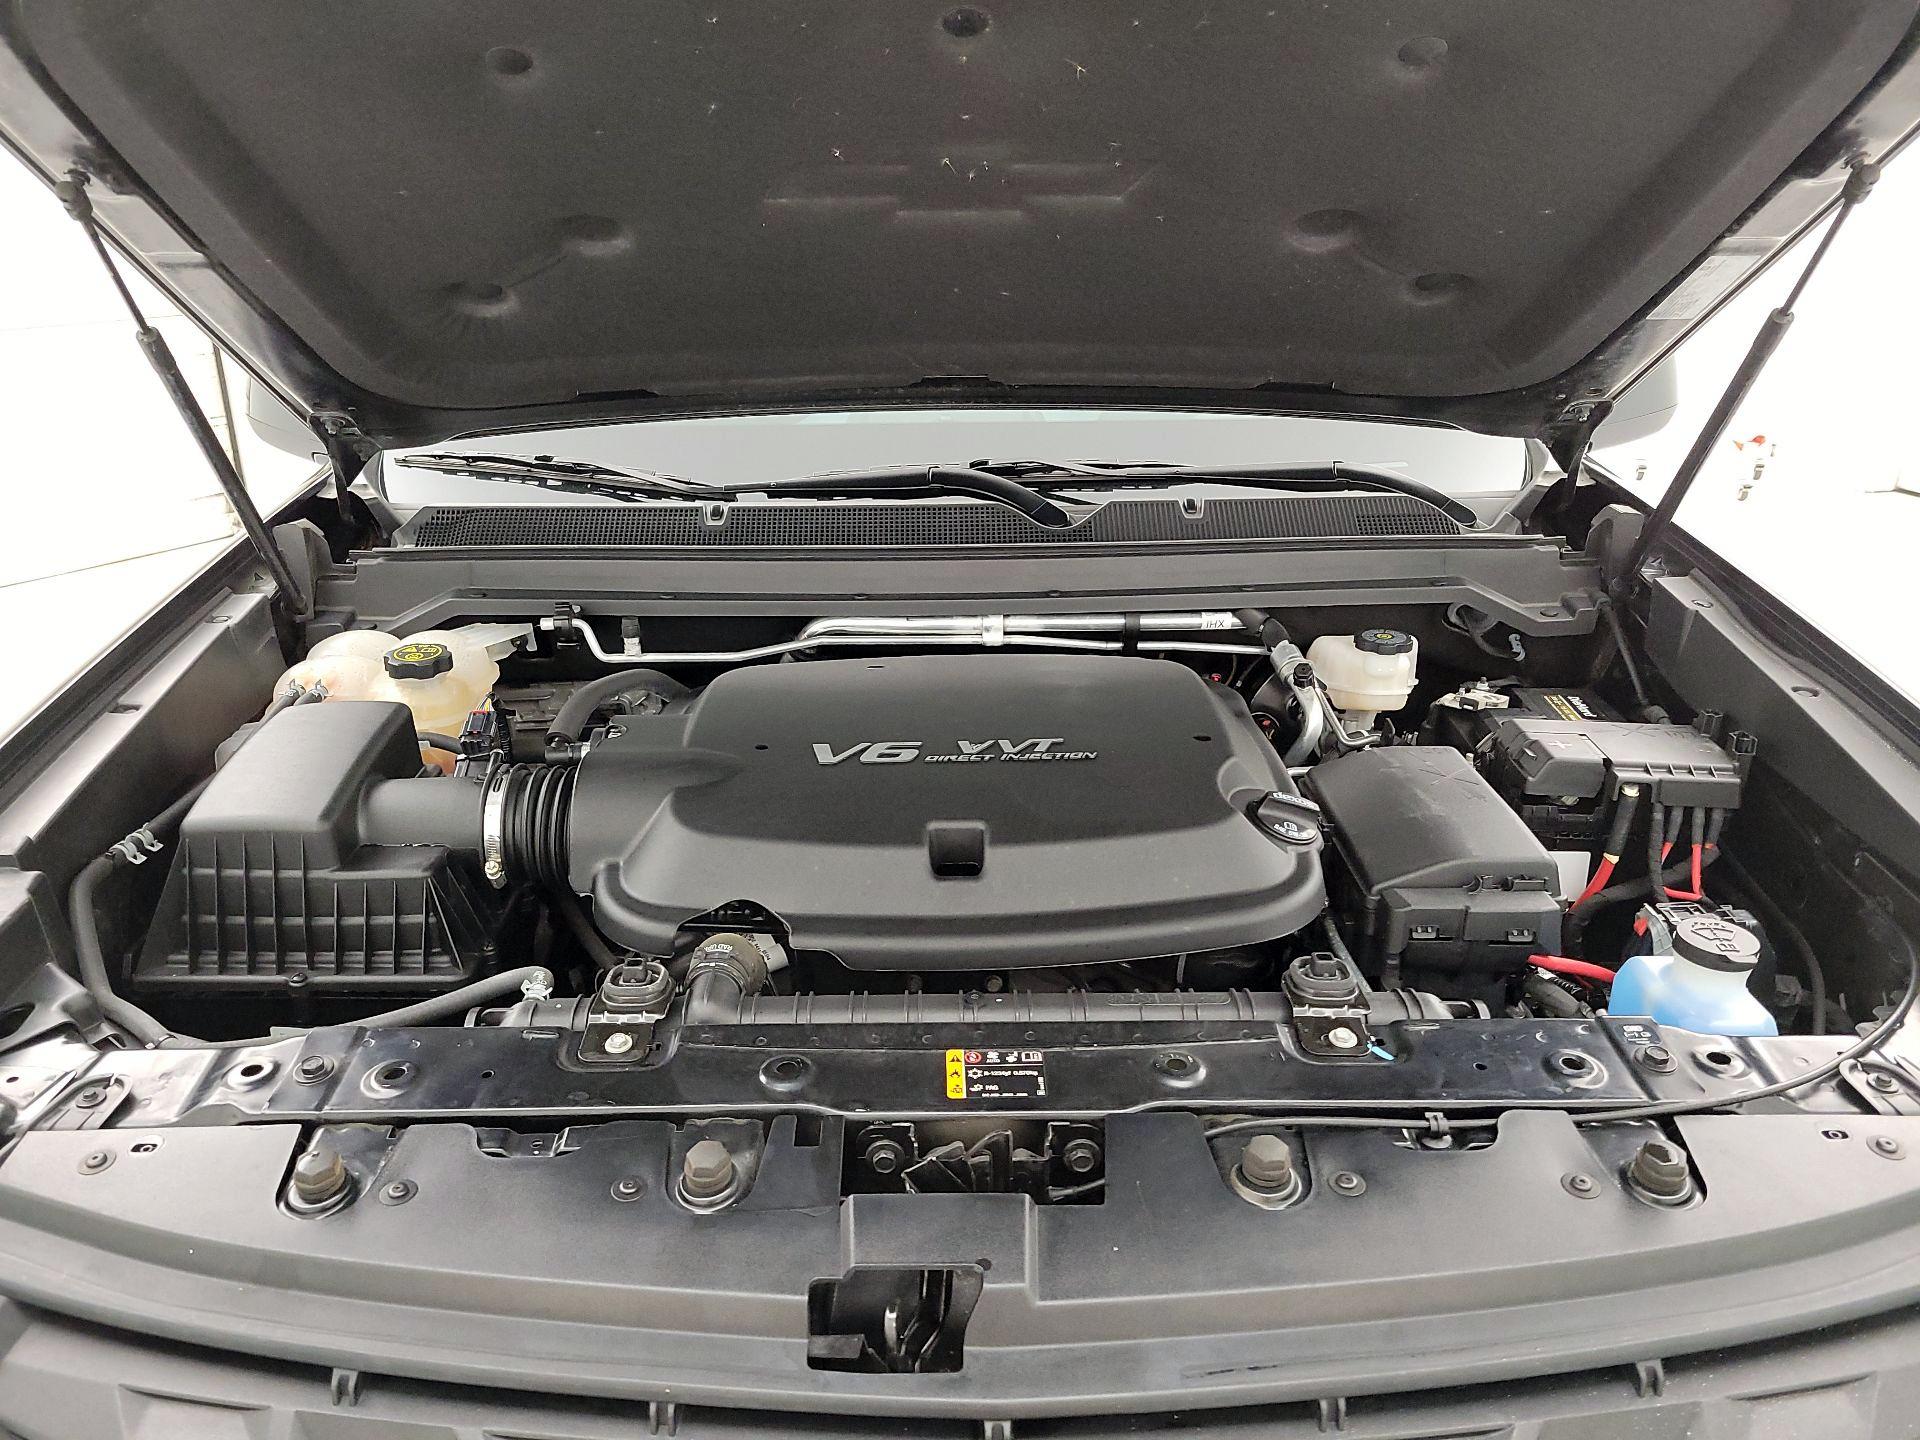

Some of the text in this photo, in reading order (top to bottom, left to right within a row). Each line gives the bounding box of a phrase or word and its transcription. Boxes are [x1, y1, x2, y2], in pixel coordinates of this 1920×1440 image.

[812, 741, 923, 765] V6
[957, 737, 1064, 754] VVT
[924, 751, 1098, 763] DIRECT INJECTION
